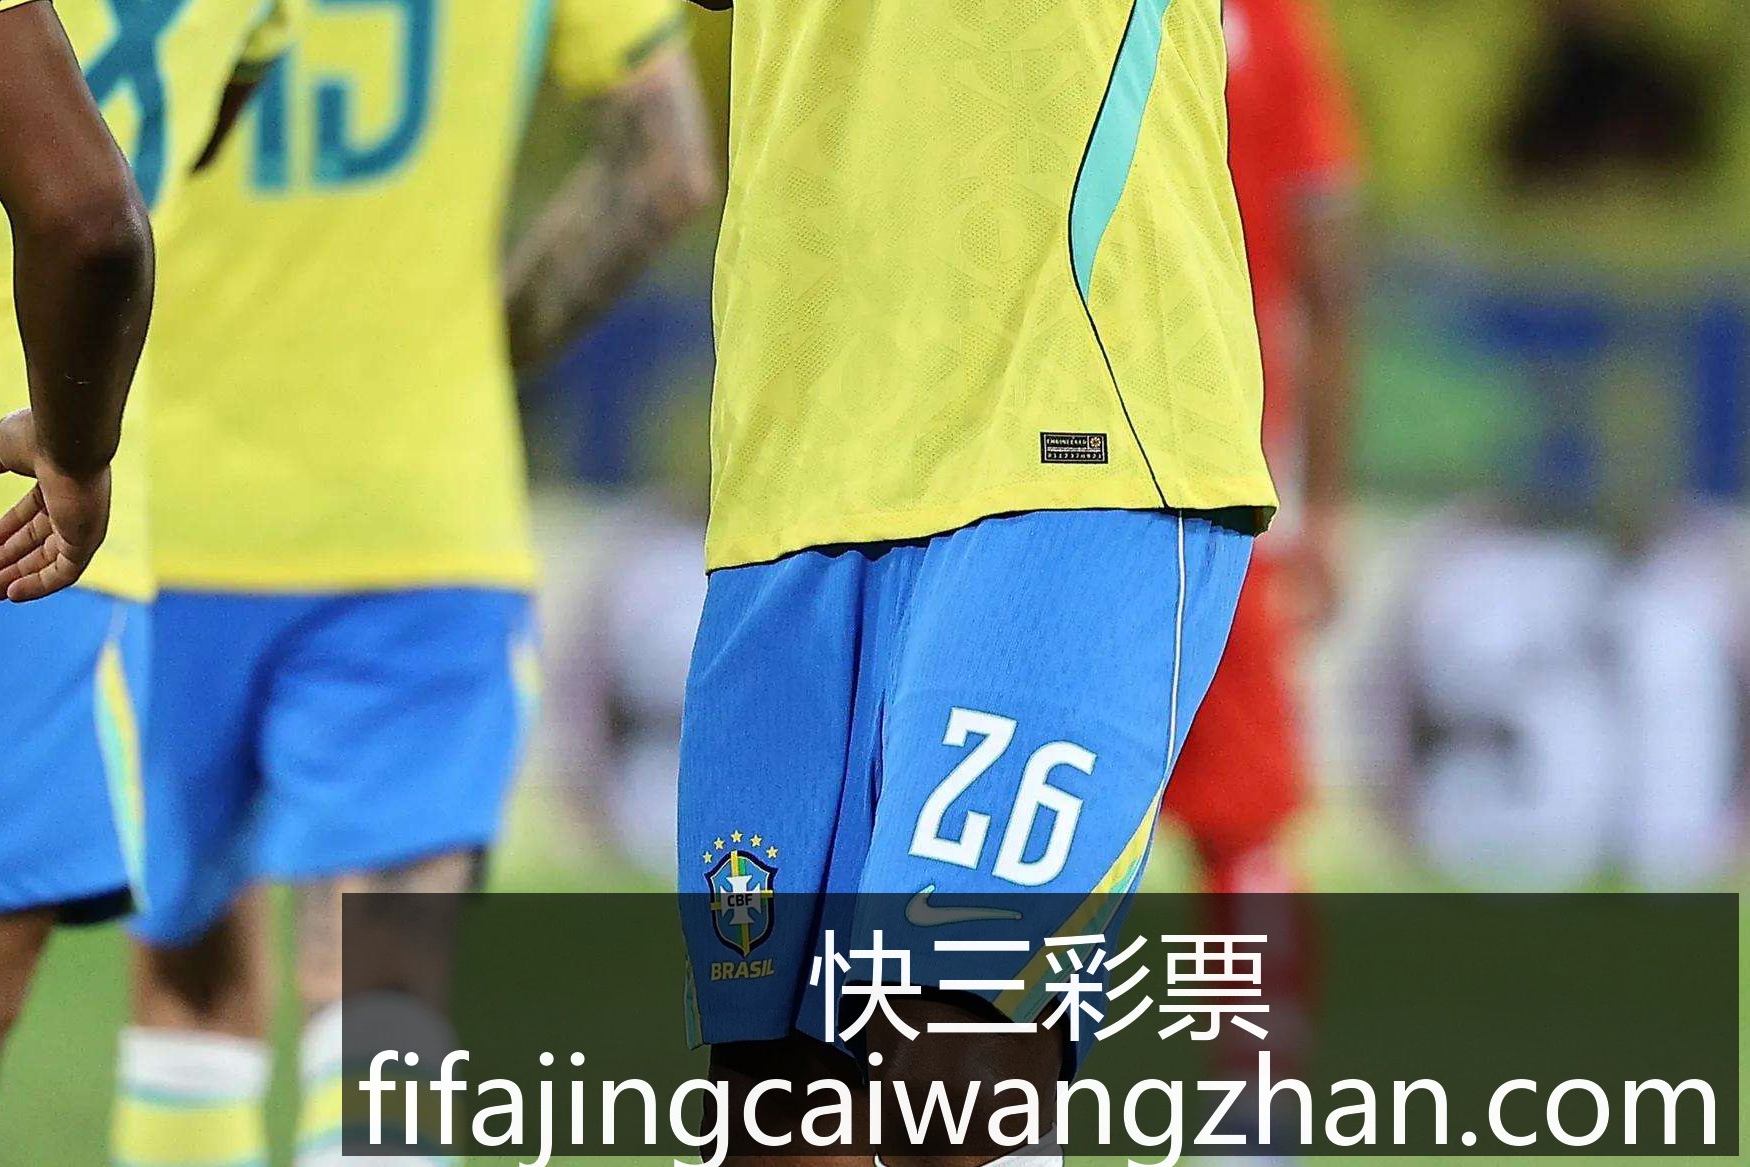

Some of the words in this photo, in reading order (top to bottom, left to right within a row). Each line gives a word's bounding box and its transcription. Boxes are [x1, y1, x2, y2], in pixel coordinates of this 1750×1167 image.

[908, 708, 1098, 888] 26
[727, 894, 753, 907] CBF
[711, 958, 775, 981] BRASIL
